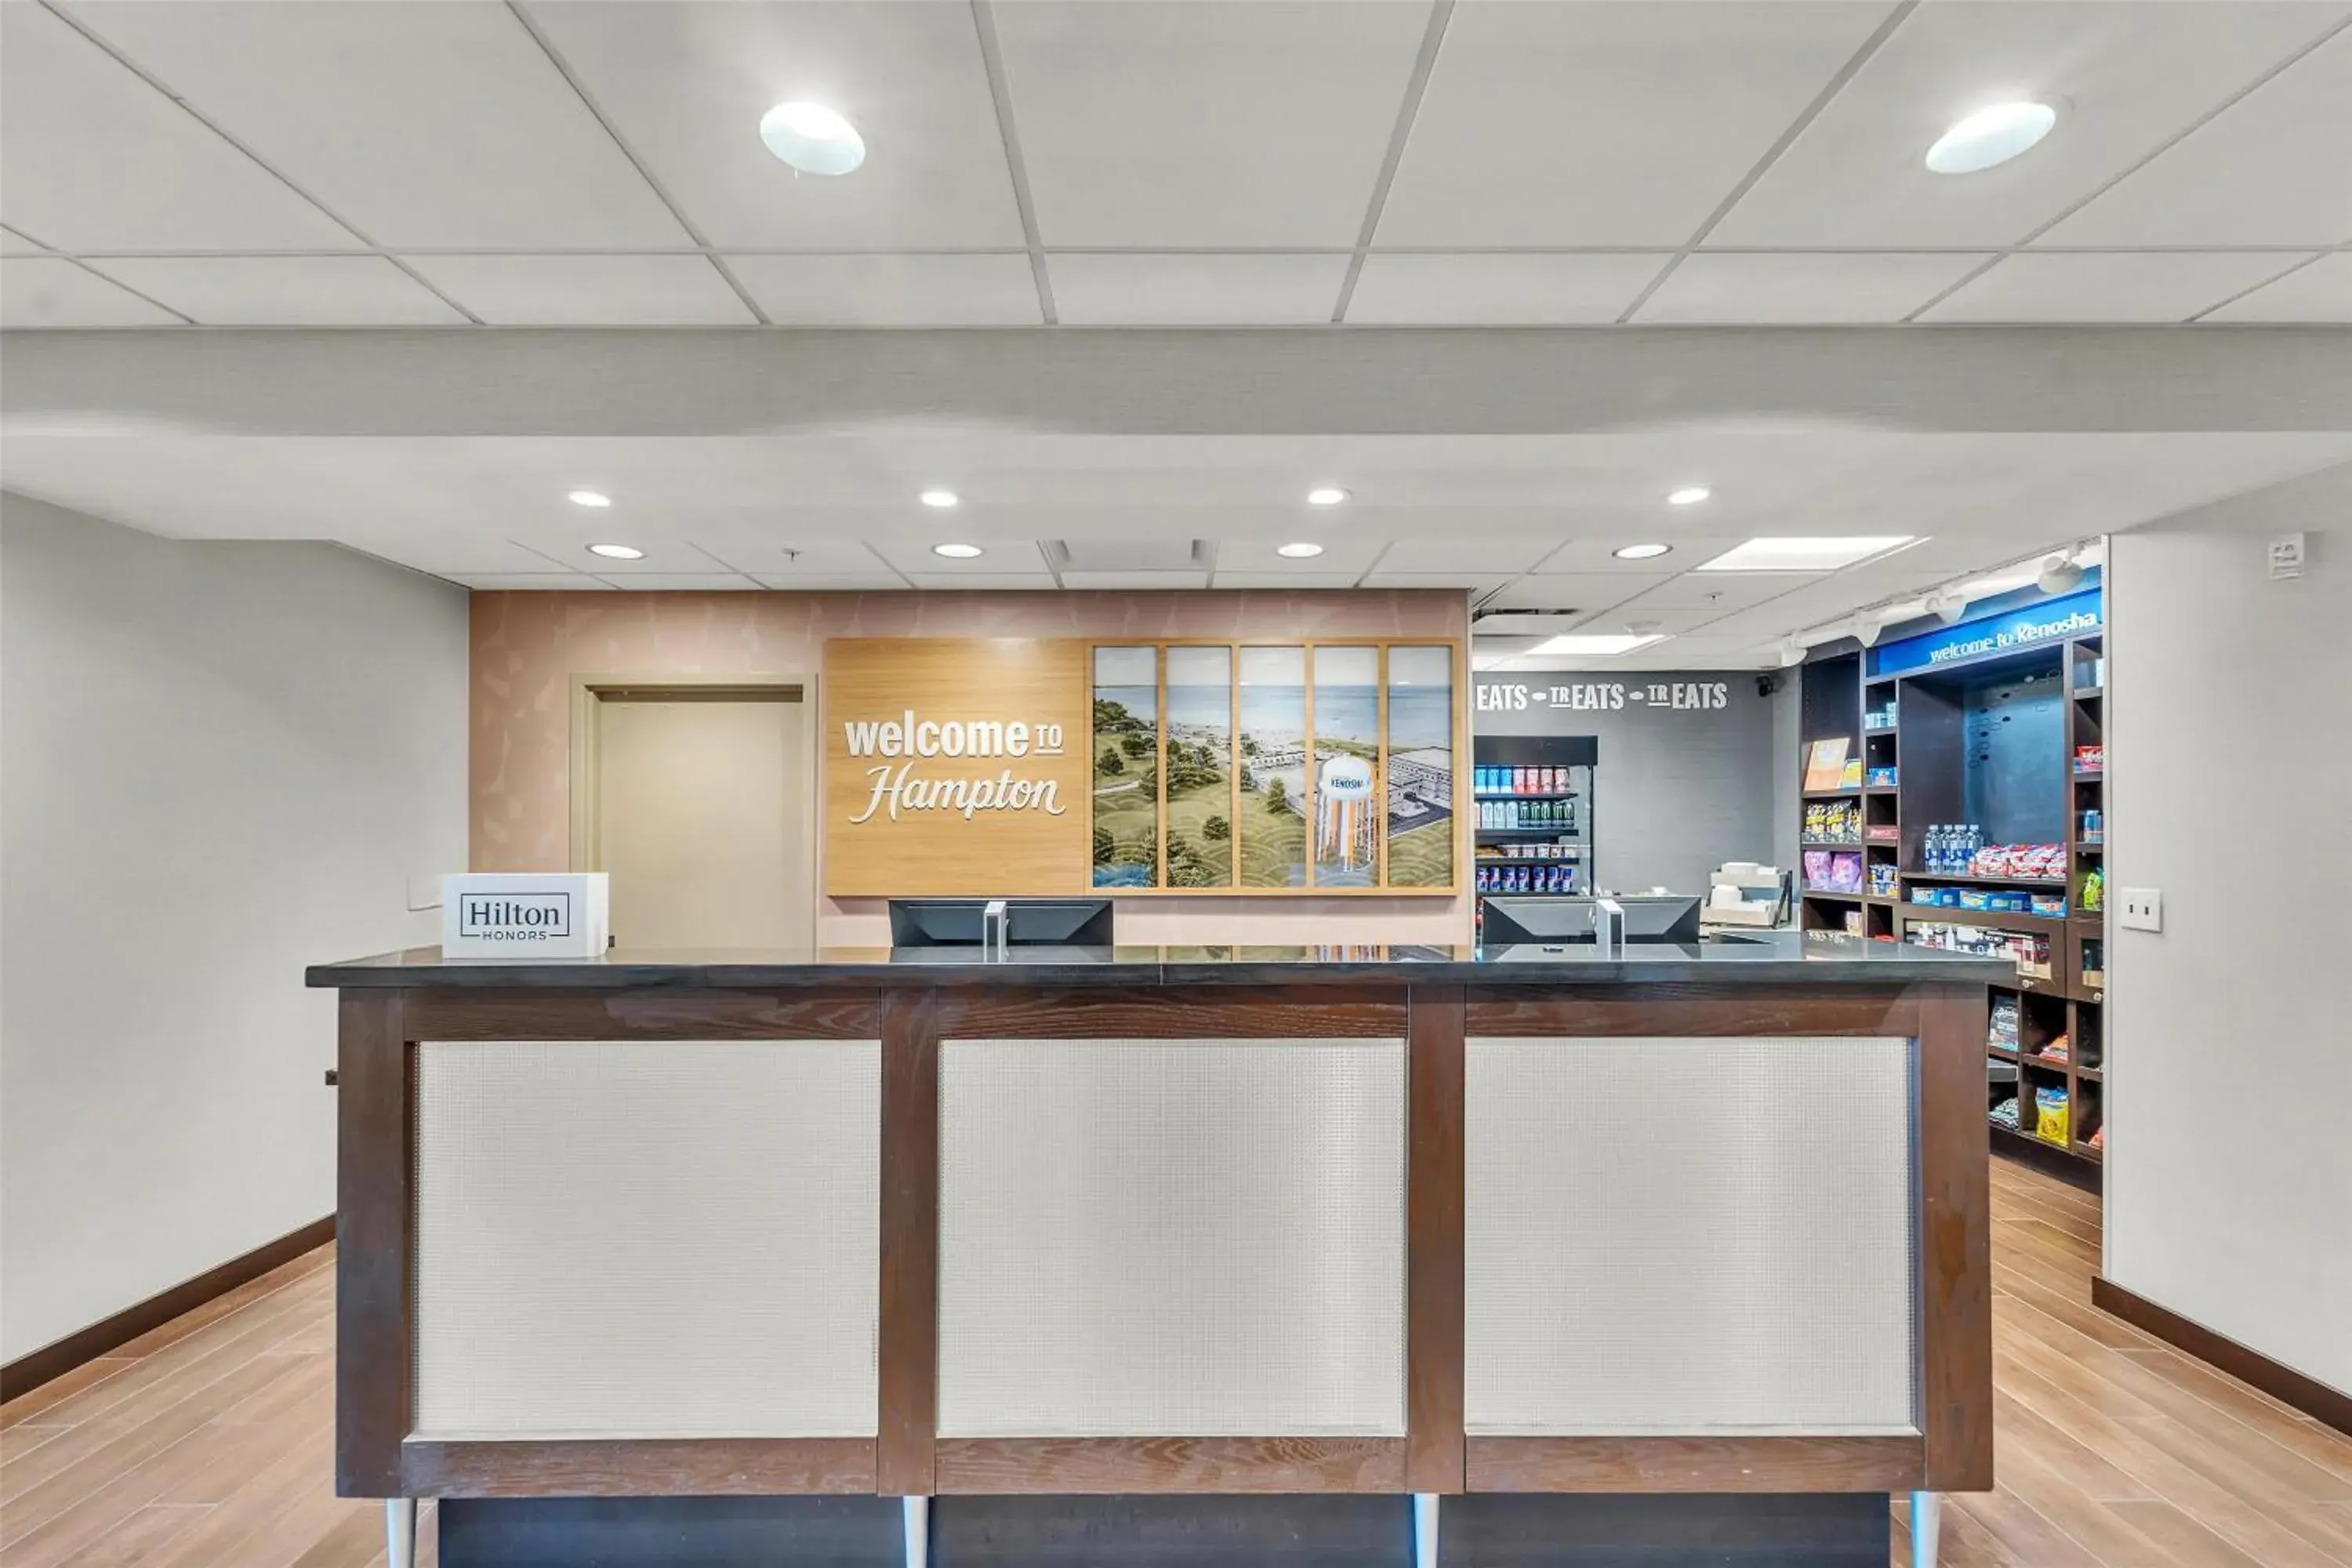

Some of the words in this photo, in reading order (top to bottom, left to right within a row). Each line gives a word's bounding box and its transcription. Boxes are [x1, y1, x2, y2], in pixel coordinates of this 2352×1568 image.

[1930, 637, 1994, 663] welcome
[1997, 632, 2014, 647] to
[844, 710, 1029, 757] welcome
[1034, 724, 1063, 749] TO
[848, 761, 1066, 823] Hampton
[470, 902, 560, 926] Hilton
[482, 931, 546, 941] HONORS
